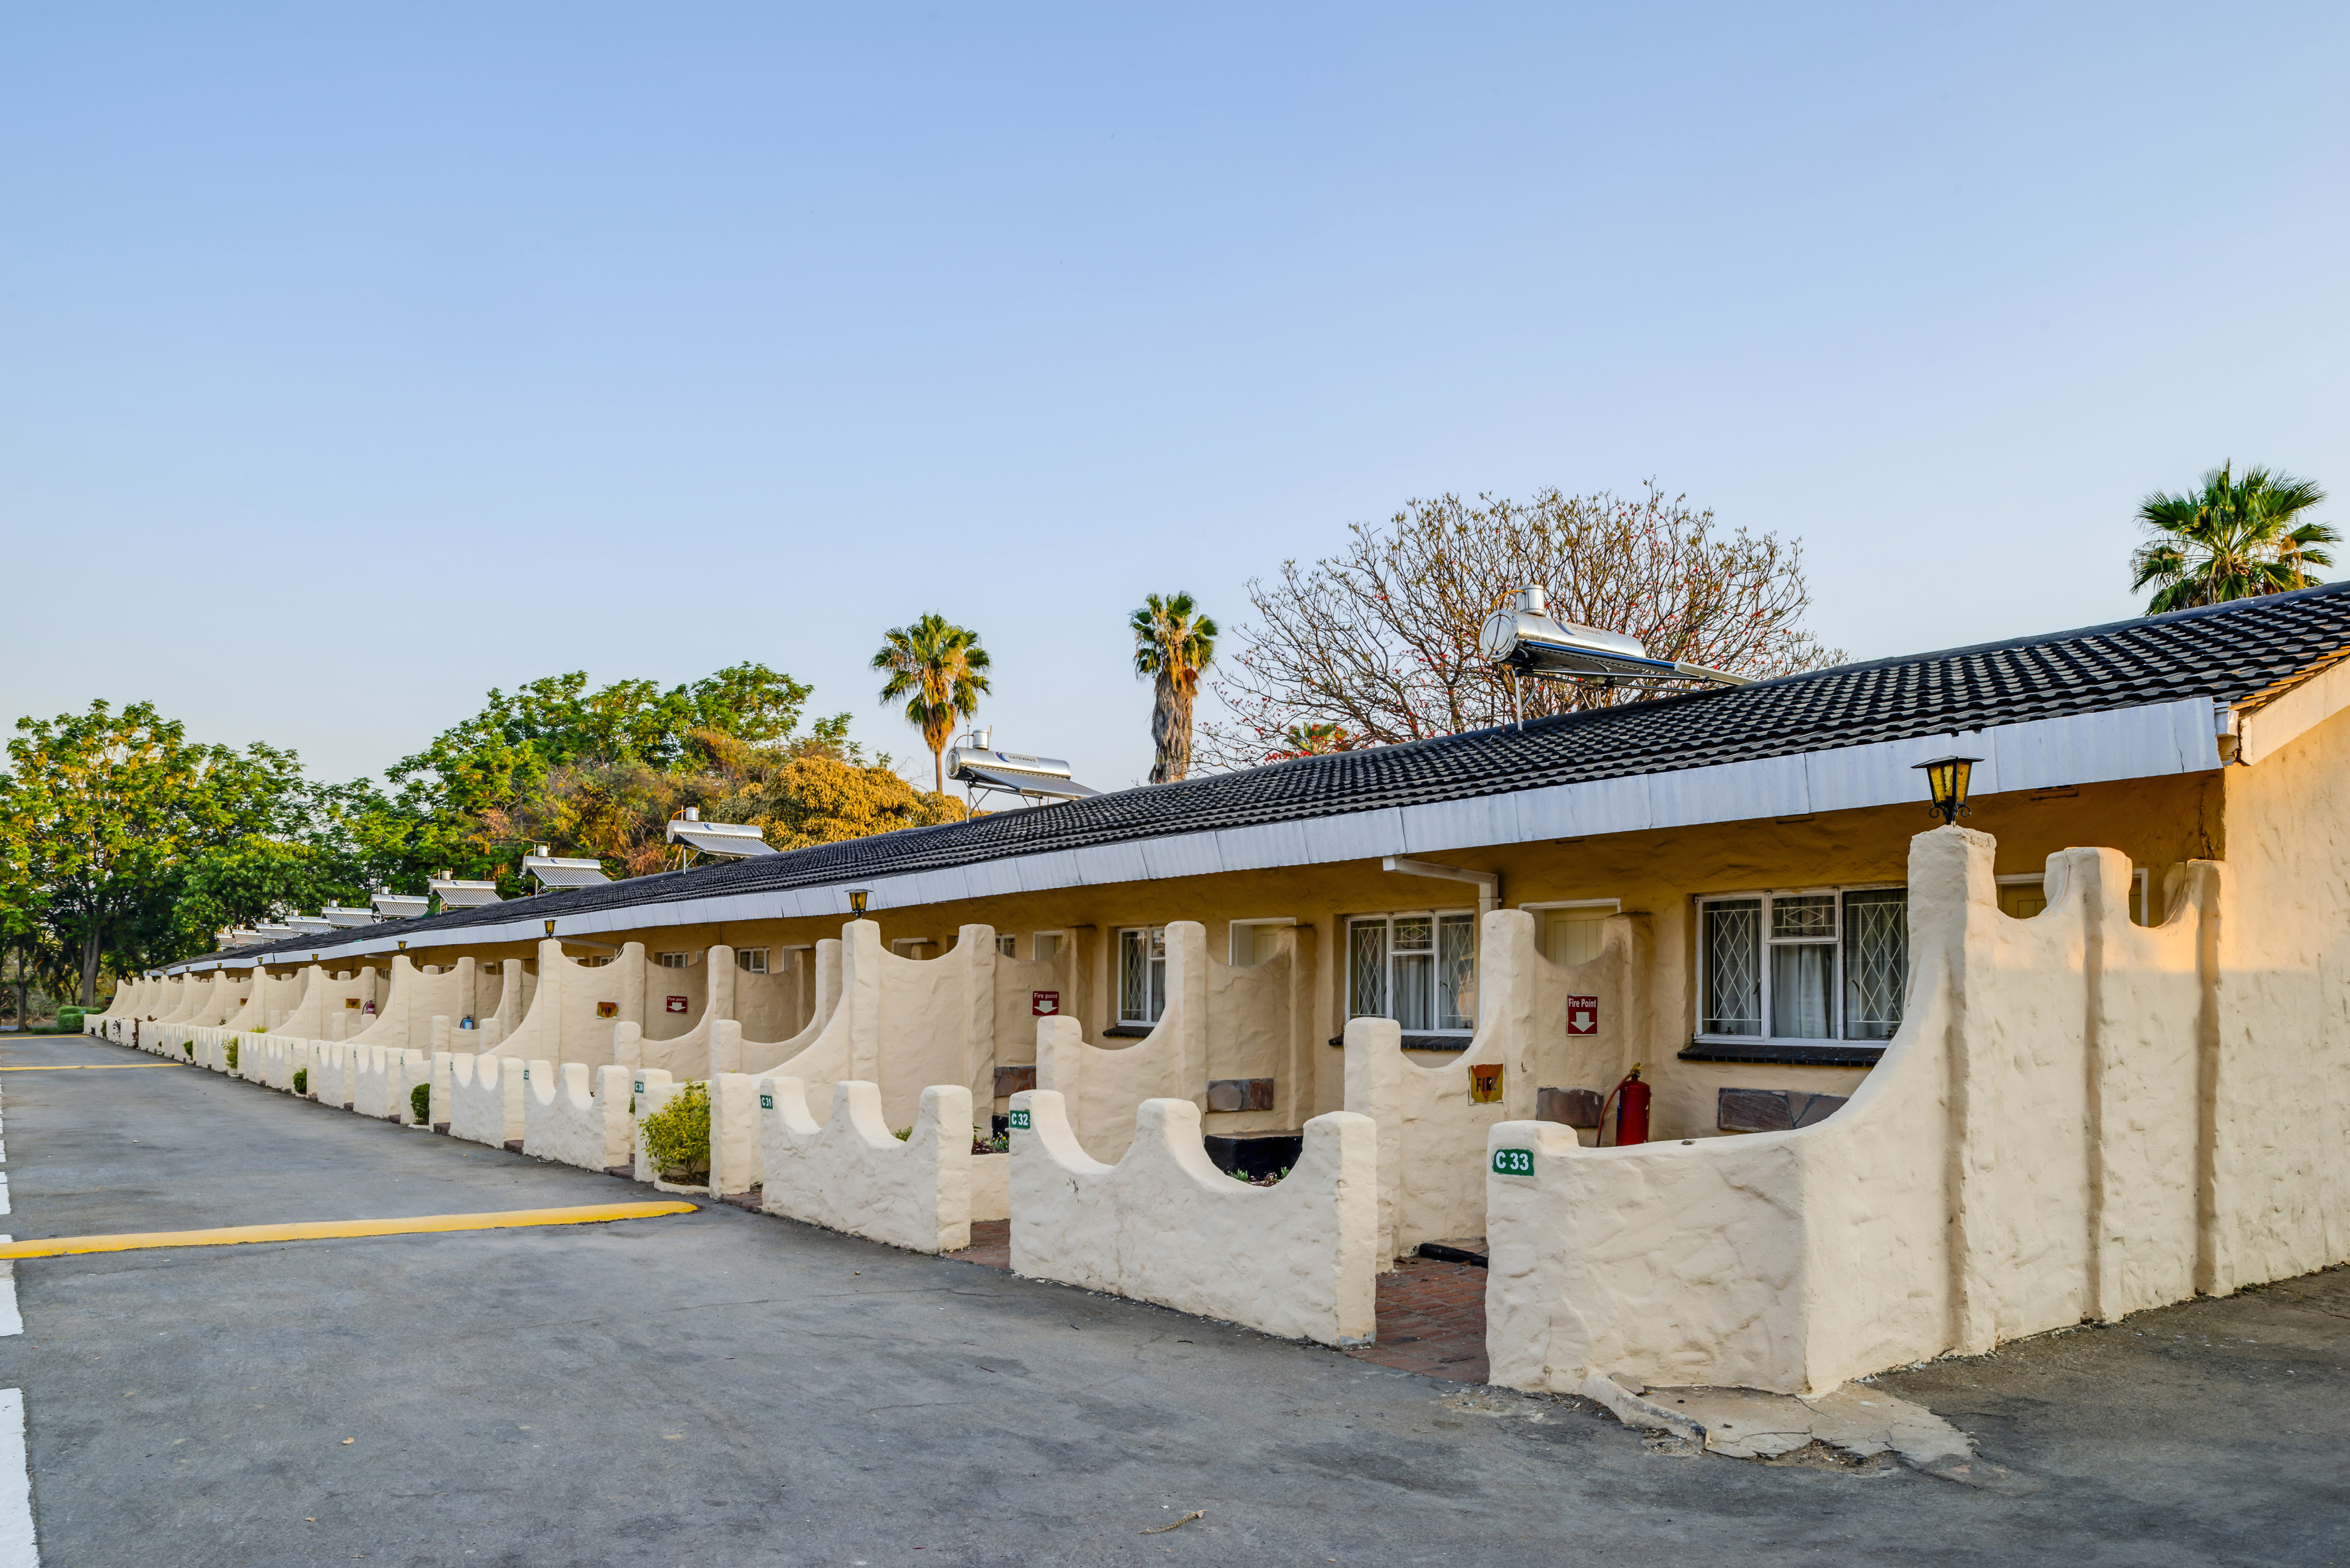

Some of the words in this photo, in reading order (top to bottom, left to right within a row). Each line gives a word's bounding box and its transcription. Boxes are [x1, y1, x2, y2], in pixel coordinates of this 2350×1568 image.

[1568, 997, 1580, 1008] Fire
[1581, 998, 1597, 1008] Point
[1476, 1077, 1497, 1092] FIRE
[1496, 1151, 1506, 1169] C
[1510, 1152, 1529, 1171] 33
